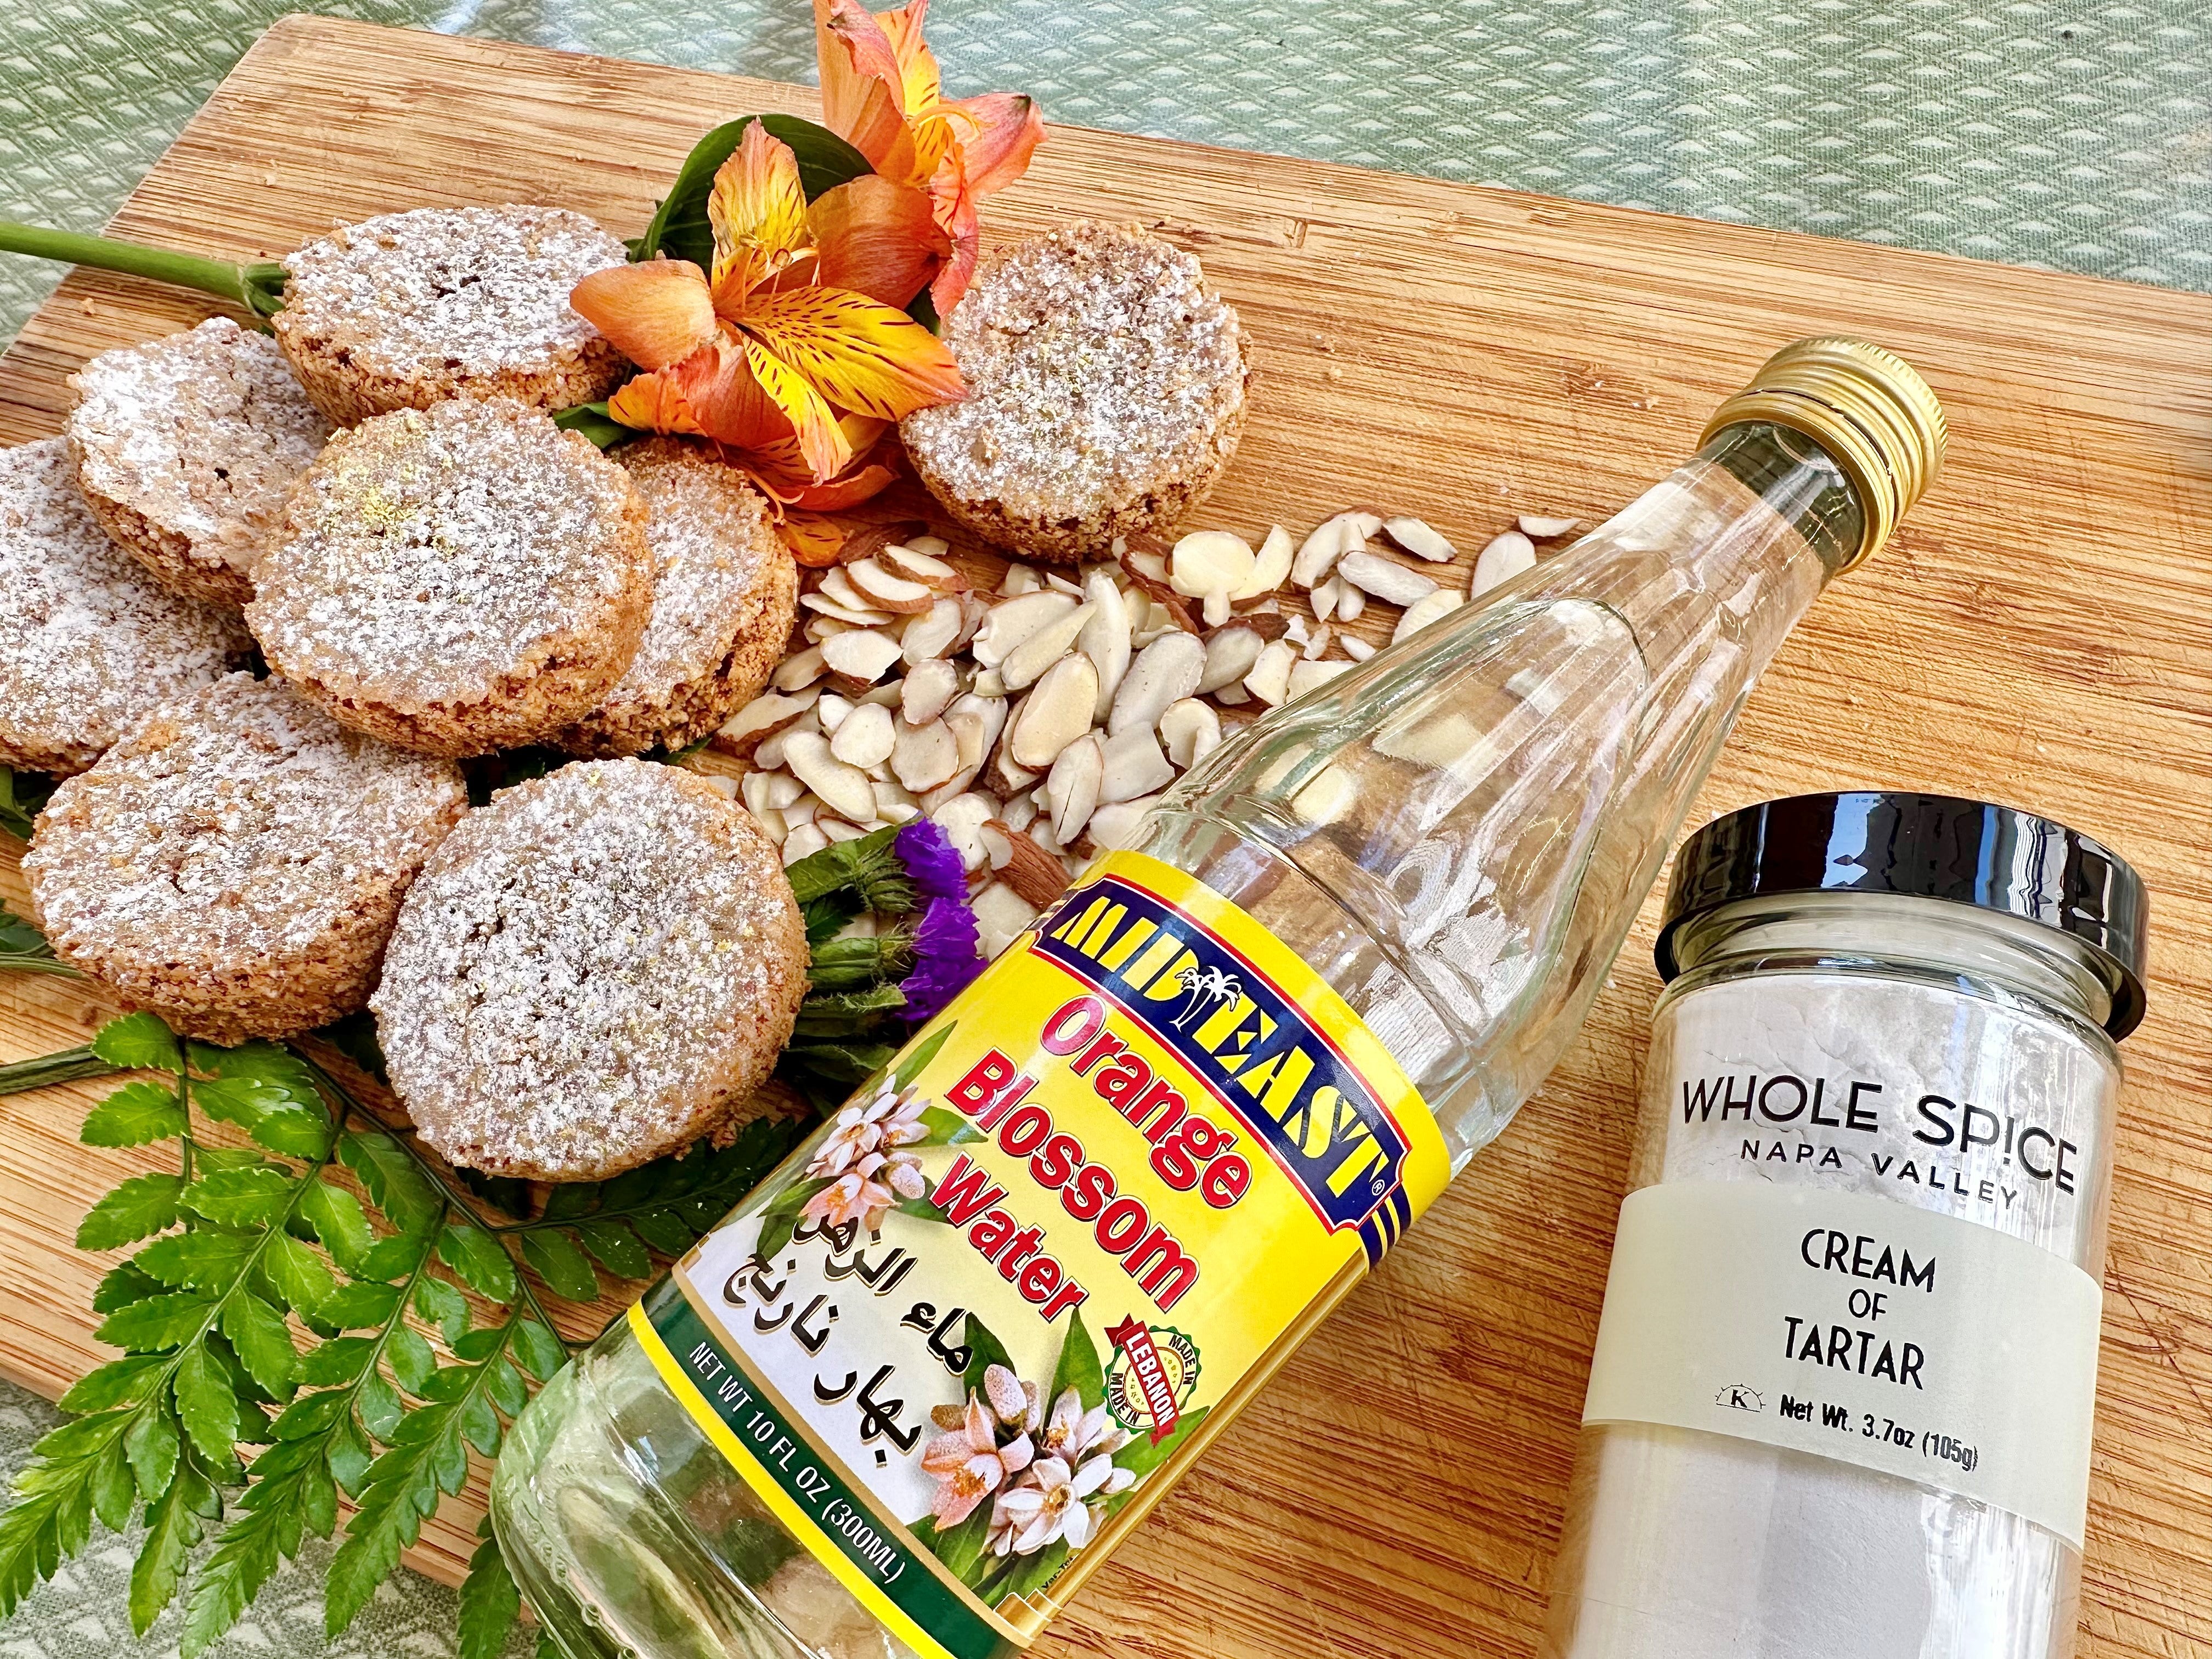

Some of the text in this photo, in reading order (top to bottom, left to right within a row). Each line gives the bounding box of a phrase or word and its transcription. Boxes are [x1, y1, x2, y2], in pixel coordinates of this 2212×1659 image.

[1040, 994, 1252, 1209] Orange
[1683, 1074, 1883, 1134] WHOLE
[944, 1046, 1200, 1314] Blossom
[1740, 1139, 2019, 1210] NAPA VALLEY
[929, 1151, 1090, 1323] Water
[1800, 1228, 1938, 1294] CREAM
[900, 1302, 974, 1376] ماء
[1848, 1288, 1888, 1321] OF
[1126, 1331, 1176, 1427] LEBANON
[1169, 1334, 1196, 1385] MADE IN
[1784, 1316, 1926, 1390] TARTAR
[813, 1364, 922, 1468] بهار
[1109, 1373, 1141, 1426] MADE IN
[1730, 1389, 1749, 1408] K
[1780, 1394, 1978, 1472] Net Wt. 3.7oz (105g)
[689, 1341, 906, 1584] NET WT 10 FL OZ (300ML)
